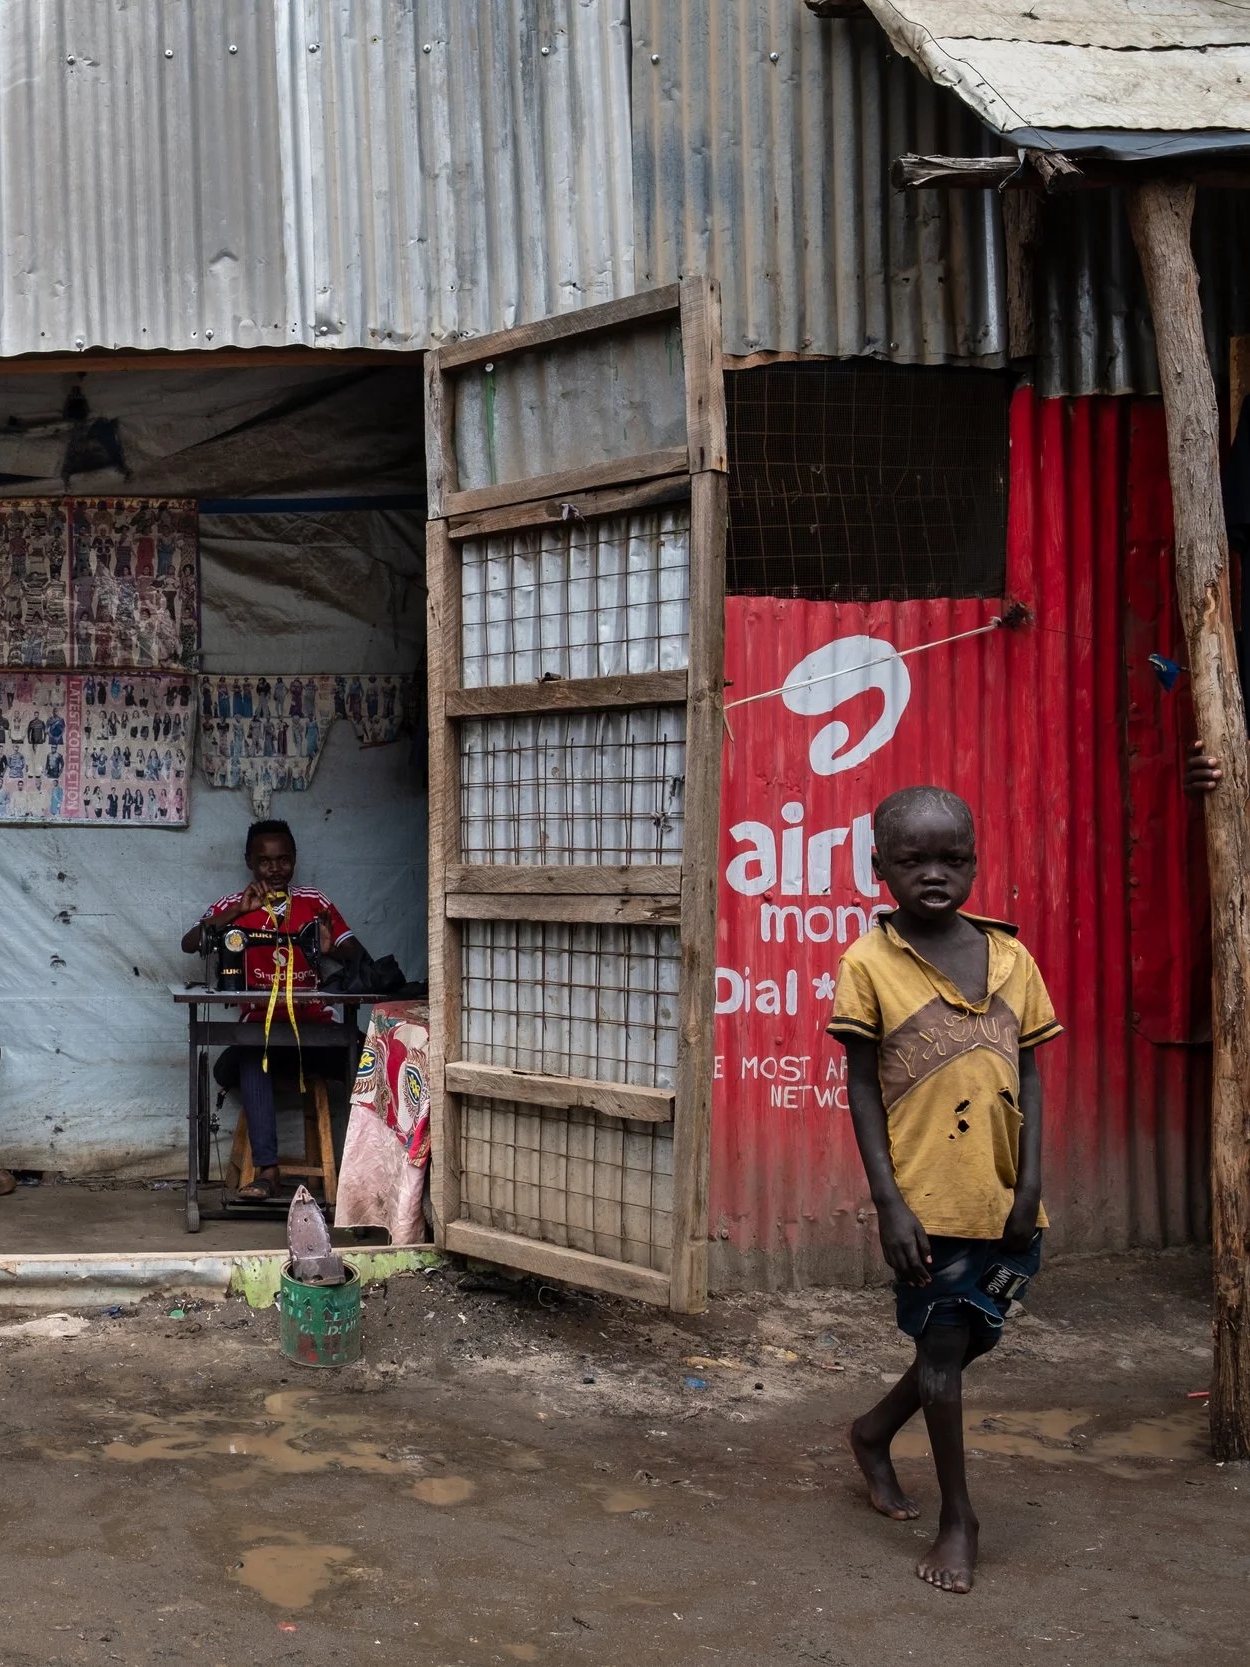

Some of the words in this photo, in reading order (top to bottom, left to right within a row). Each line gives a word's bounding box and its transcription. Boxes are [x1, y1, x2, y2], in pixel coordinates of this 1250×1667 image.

[68, 680, 82, 726] LATEST
[67, 732, 82, 811] COLLECTION
[714, 966, 798, 1015] Dial
[741, 1055, 811, 1081] MOST
